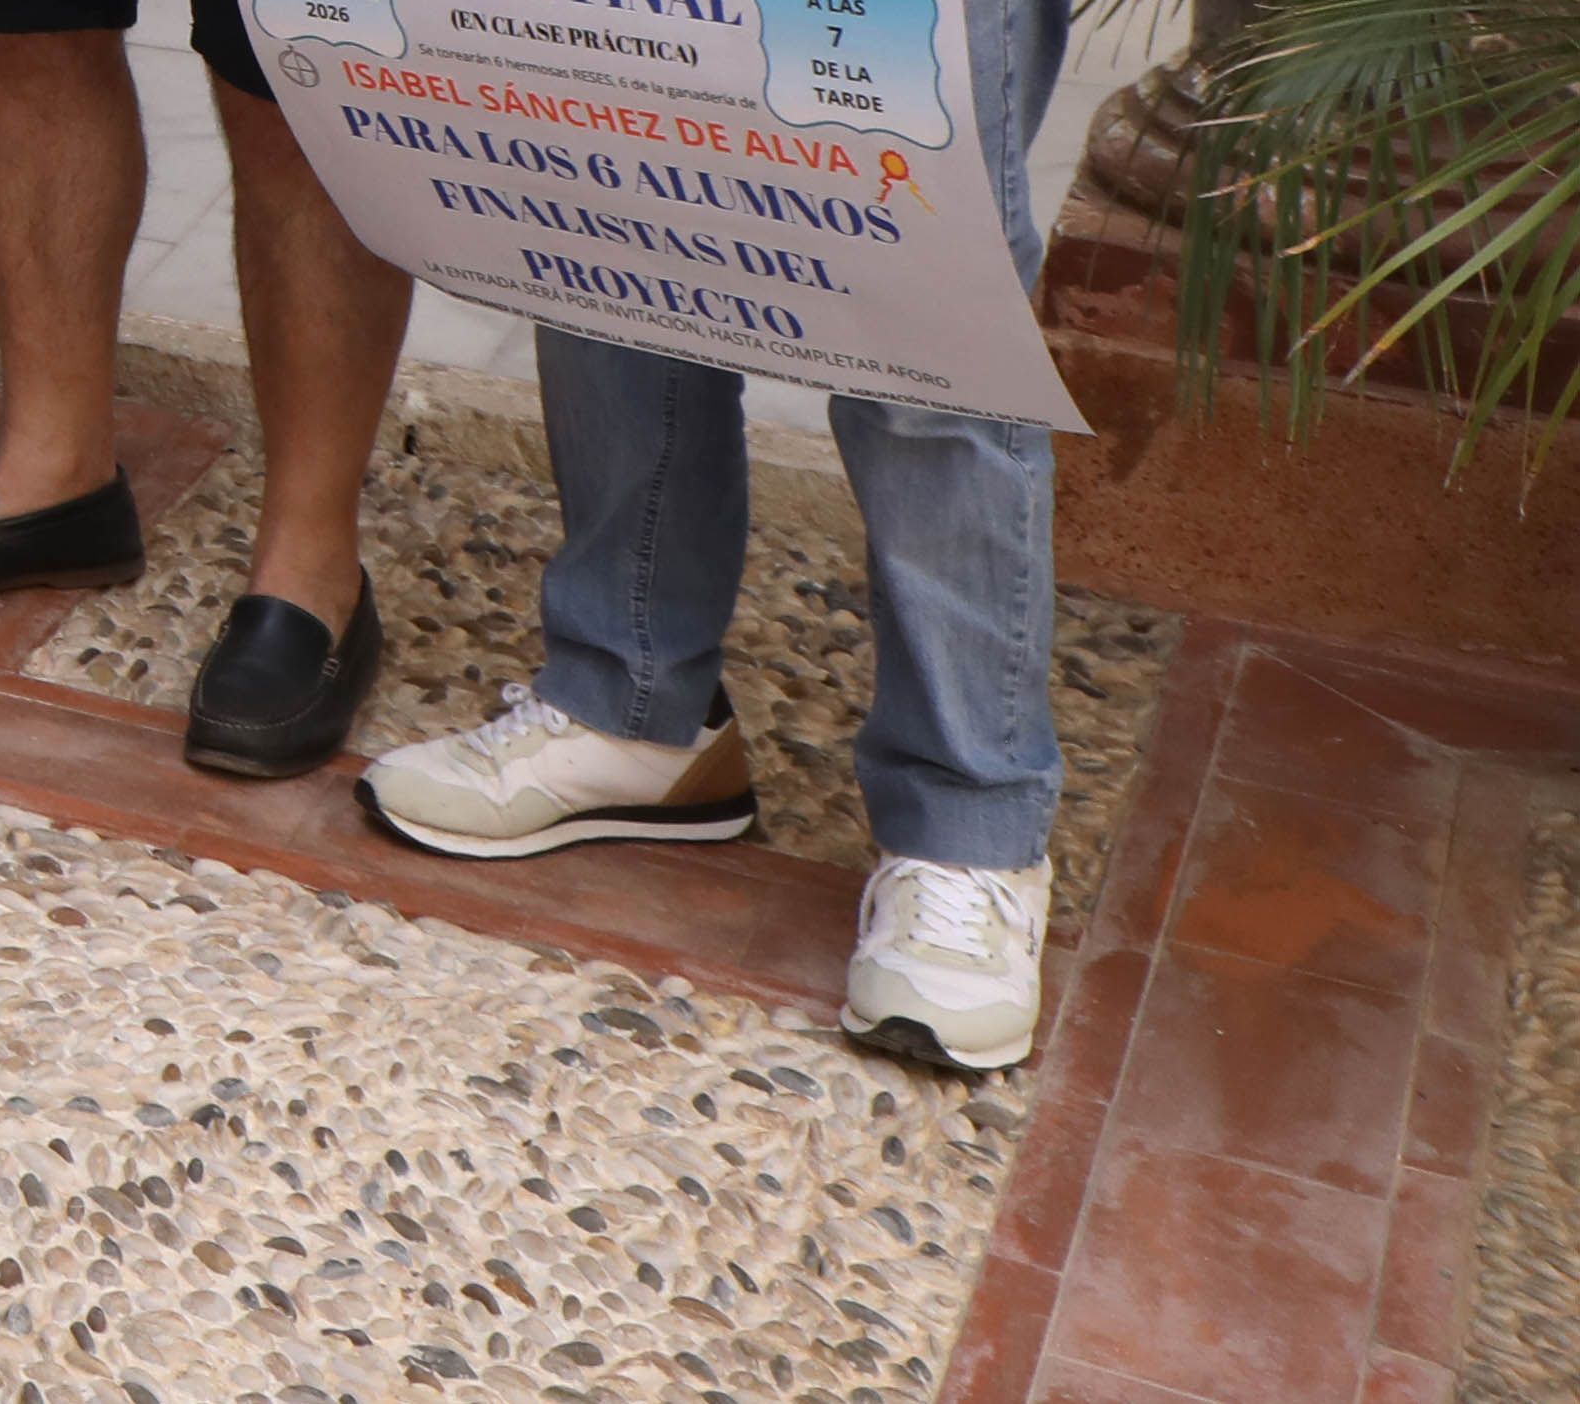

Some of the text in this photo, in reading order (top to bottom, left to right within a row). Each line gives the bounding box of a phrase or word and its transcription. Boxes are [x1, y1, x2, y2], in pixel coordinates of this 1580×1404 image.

[342, 61, 859, 176] ISABEL SÁNCHEZ DE ALVA
